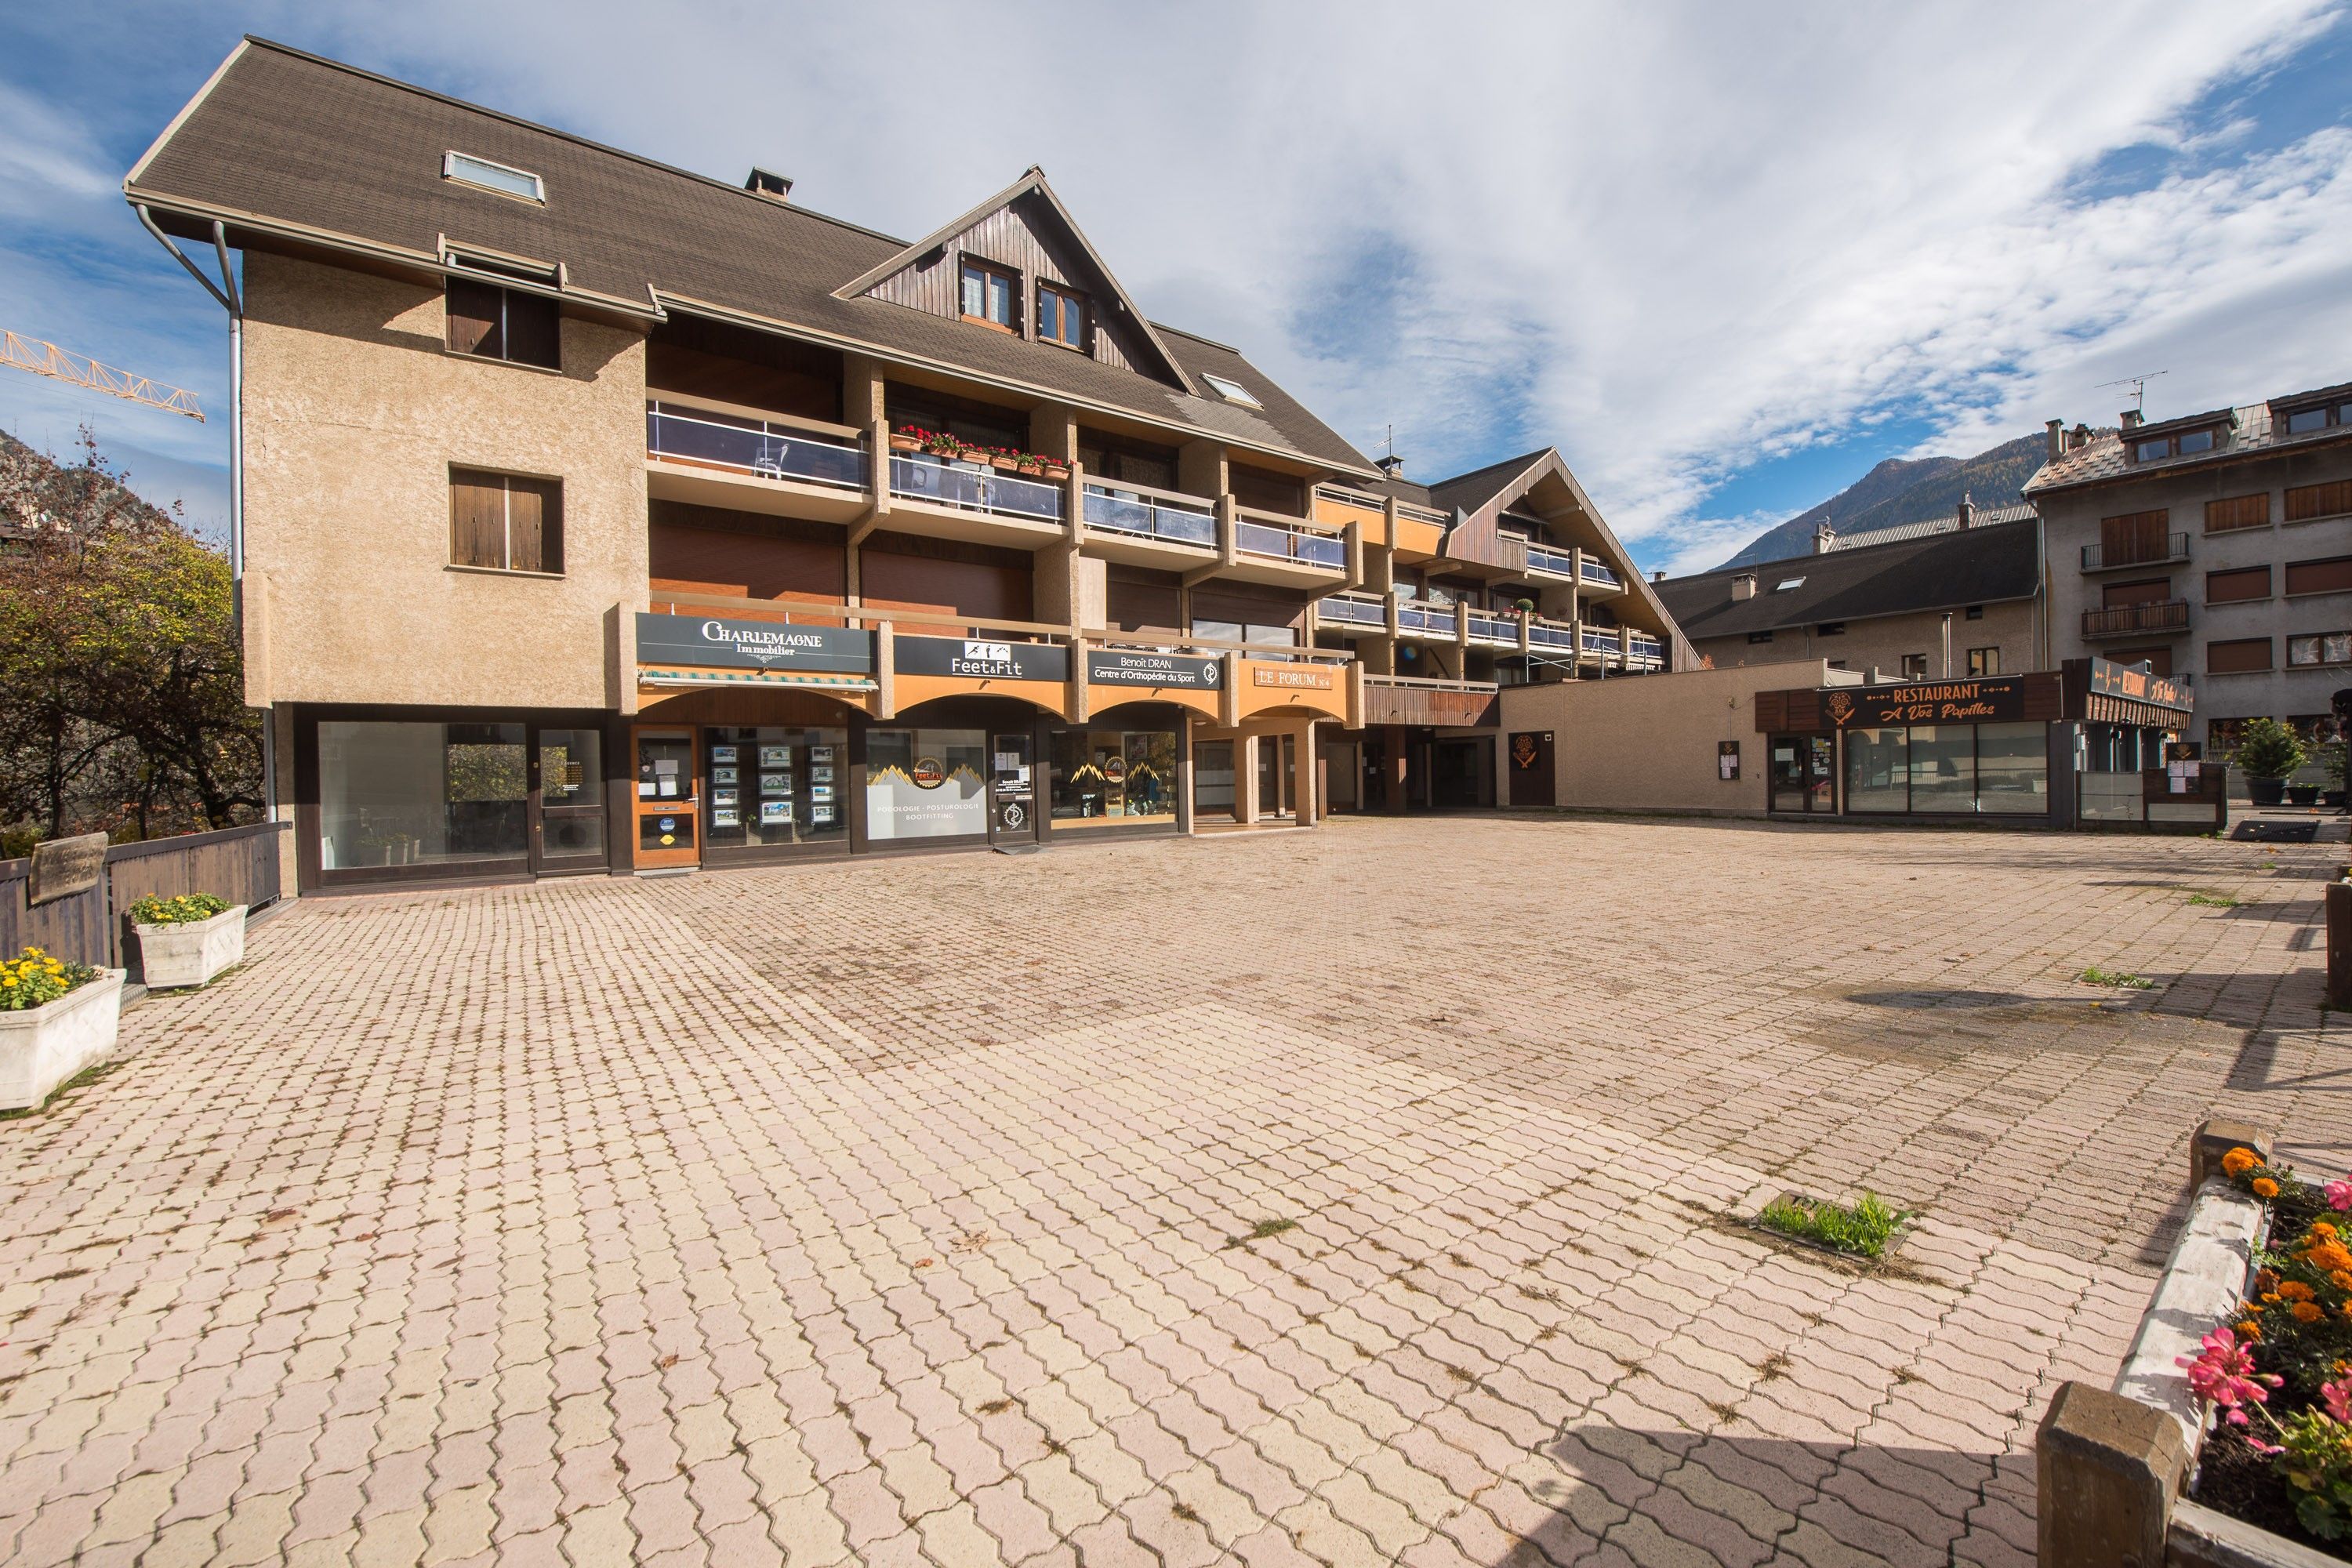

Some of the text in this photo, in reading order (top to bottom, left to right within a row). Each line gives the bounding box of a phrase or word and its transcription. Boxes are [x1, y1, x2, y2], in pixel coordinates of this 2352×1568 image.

[702, 621, 822, 648] CHARLEMAGNE
[736, 644, 796, 656] Immobilier
[1120, 657, 1171, 669] Benoît DRAN
[1094, 669, 1120, 678] Centre
[1167, 673, 1177, 682] du
[1178, 674, 1196, 684] Sport
[1260, 670, 1274, 684] LE
[1279, 672, 1316, 686] FORUM
[1893, 684, 1980, 703] RESTAURANT
[1880, 702, 1994, 721] A Vos Papilles
